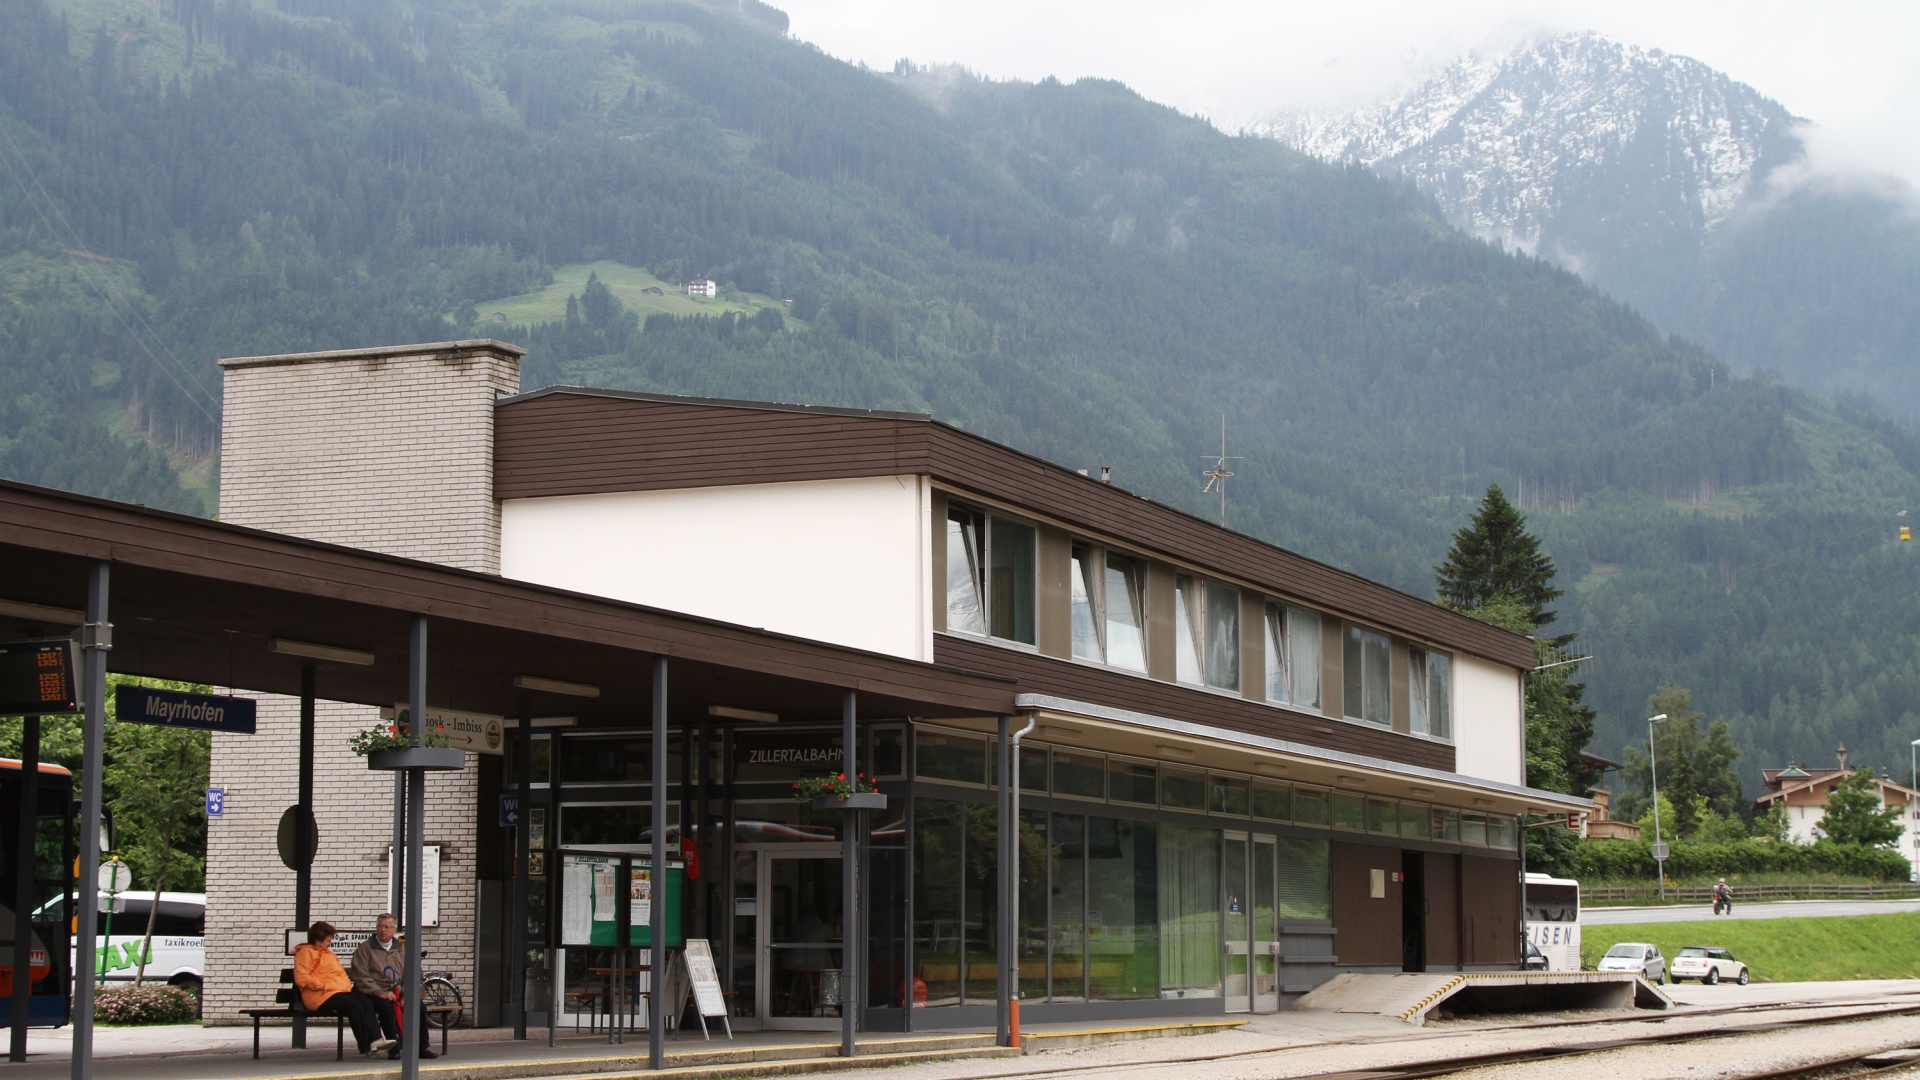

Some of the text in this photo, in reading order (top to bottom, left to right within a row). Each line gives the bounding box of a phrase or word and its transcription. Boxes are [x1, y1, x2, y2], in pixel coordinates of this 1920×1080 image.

[145, 695, 224, 723] Mayrhofen
[425, 714, 444, 728] iosk
[452, 717, 482, 733] Imbiss
[209, 792, 221, 803] WC
[1568, 812, 1580, 828] E
[96, 939, 153, 974] TAXI
